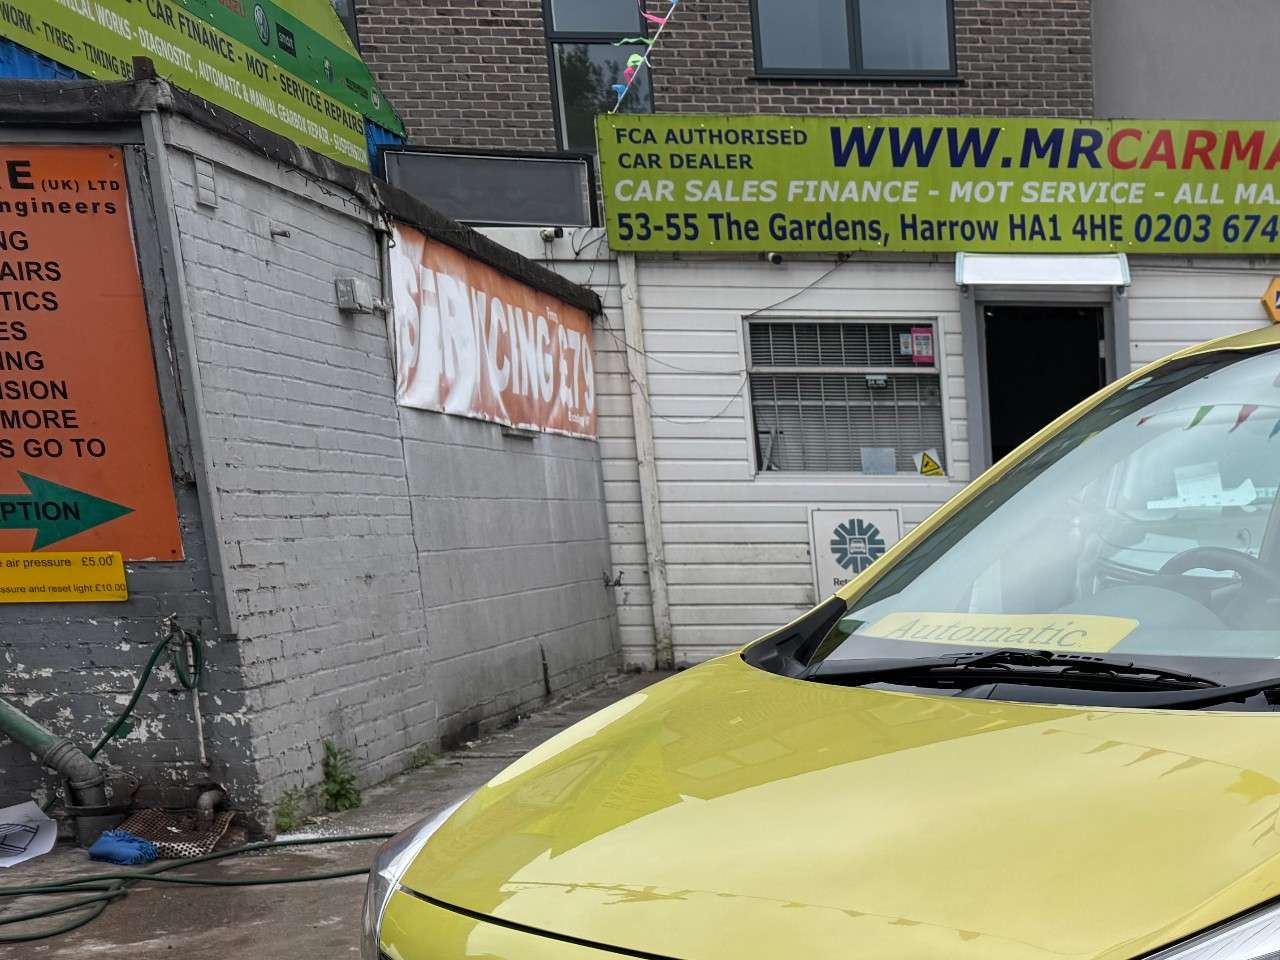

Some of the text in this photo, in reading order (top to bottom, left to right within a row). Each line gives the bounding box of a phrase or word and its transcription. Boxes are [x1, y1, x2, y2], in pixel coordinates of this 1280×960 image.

[0, 1, 35, 35] WORK
[41, 21, 75, 53] TYRES
[82, 41, 119, 75] TIMING
[95, 2, 132, 40] WORKS
[138, 26, 193, 73] DIAGNOSTIC
[198, 60, 242, 100] AUTOMATIC
[146, 0, 177, 29] CAR
[178, 12, 235, 62] FINANCE
[245, 52, 269, 83] MOT
[279, 73, 322, 113] SERVICE
[323, 99, 364, 136] REPAIRS
[616, 128, 808, 146] FCA AUTHORISED
[618, 153, 754, 171] CAR DEALER
[41, 178, 80, 193] (UK)
[87, 179, 120, 191] LTD
[614, 179, 676, 202] CAR
[684, 180, 778, 202] SALES
[788, 181, 920, 203] FINANCE
[950, 182, 1013, 203] MOT
[1022, 182, 1144, 205] SERVICE
[1173, 184, 1225, 206] ALL
[617, 212, 699, 241] 53-55
[708, 212, 760, 241] The
[768, 212, 890, 246] Gardens,
[900, 213, 999, 241] Harrow
[1009, 215, 1061, 242] HA1
[1073, 215, 1123, 242] 4HE
[1134, 214, 1211, 243] 0203
[1222, 215, 1280, 243] 674
[0, 409, 79, 429] MORE
[24, 438, 63, 458] GO
[70, 438, 106, 458] TO
[6, 556, 113, 569] air pressure £5.00
[29, 584, 46, 593] and
[48, 585, 71, 593] reset
[73, 584, 93, 594] light
[885, 617, 1087, 648] Automatic
